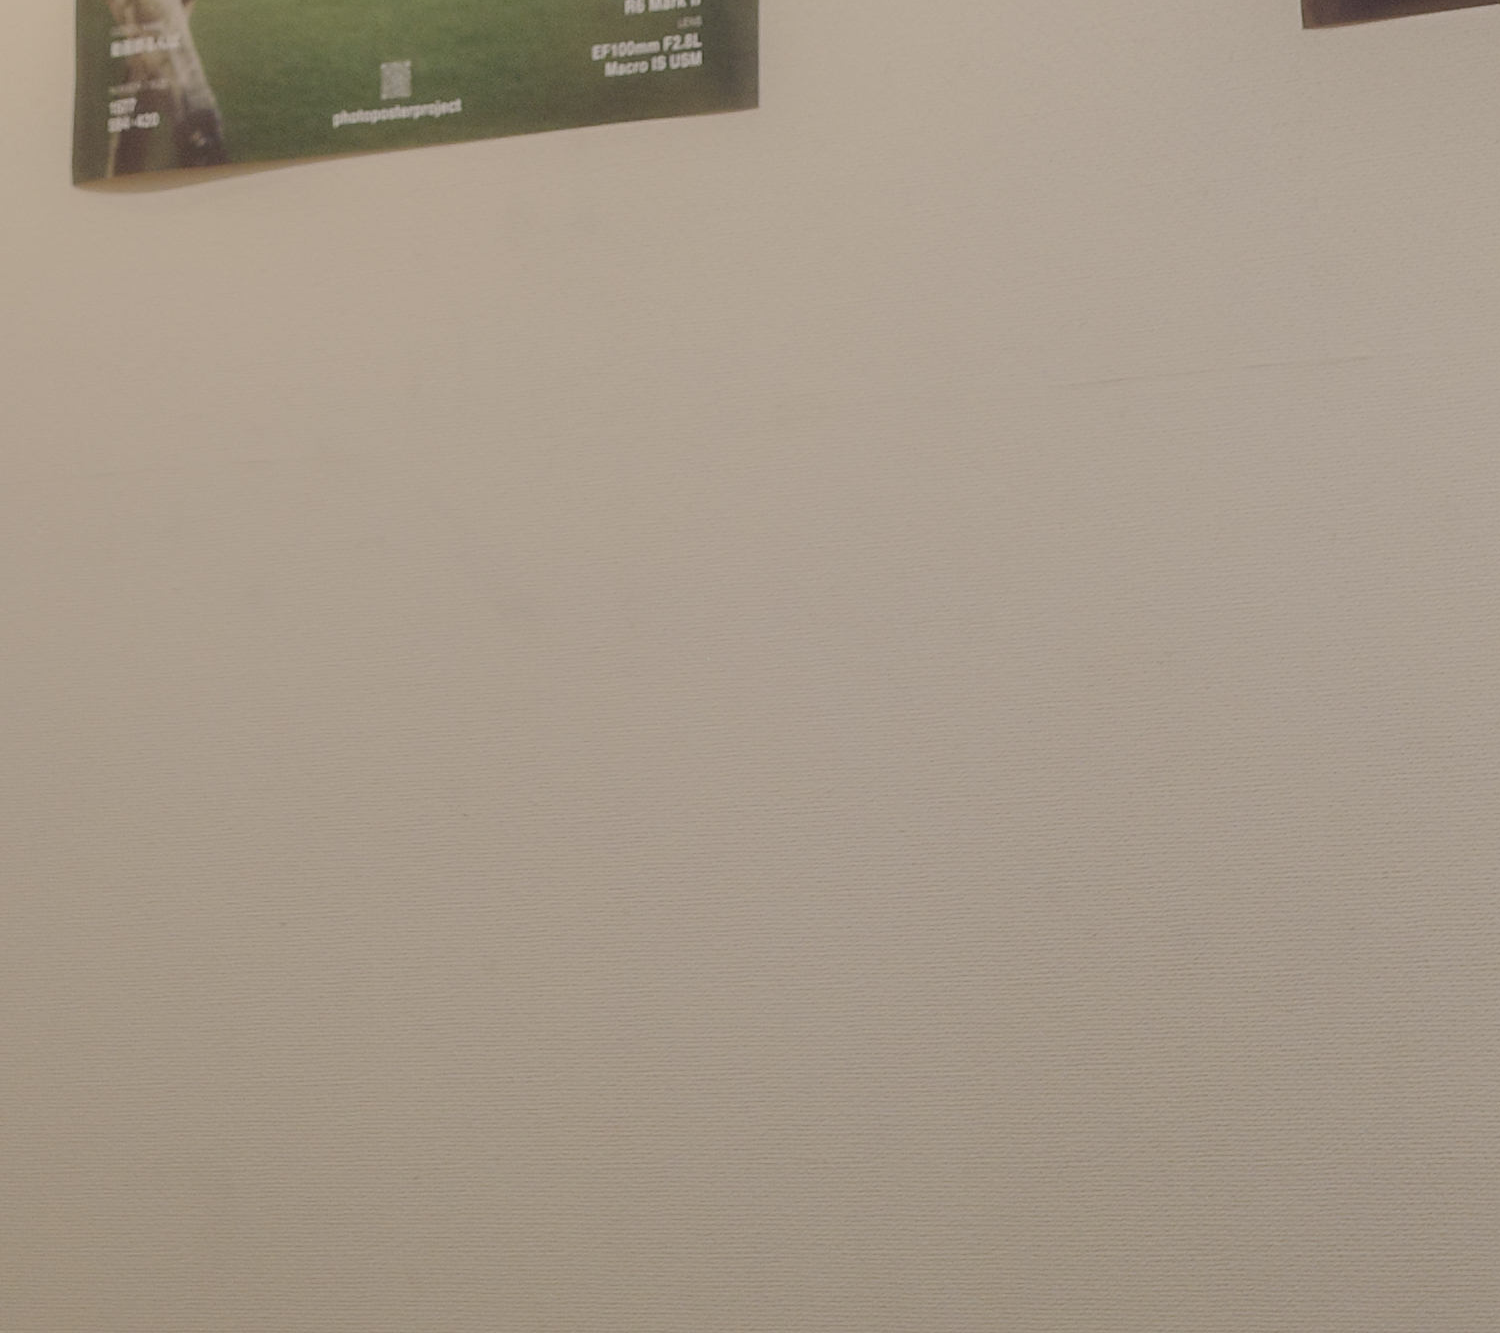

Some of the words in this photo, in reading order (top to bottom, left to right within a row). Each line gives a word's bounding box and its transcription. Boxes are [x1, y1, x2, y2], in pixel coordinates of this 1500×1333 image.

[604, 60, 650, 78] Macro
[668, 50, 703, 70] USM
[332, 98, 462, 129] photoposterproject
